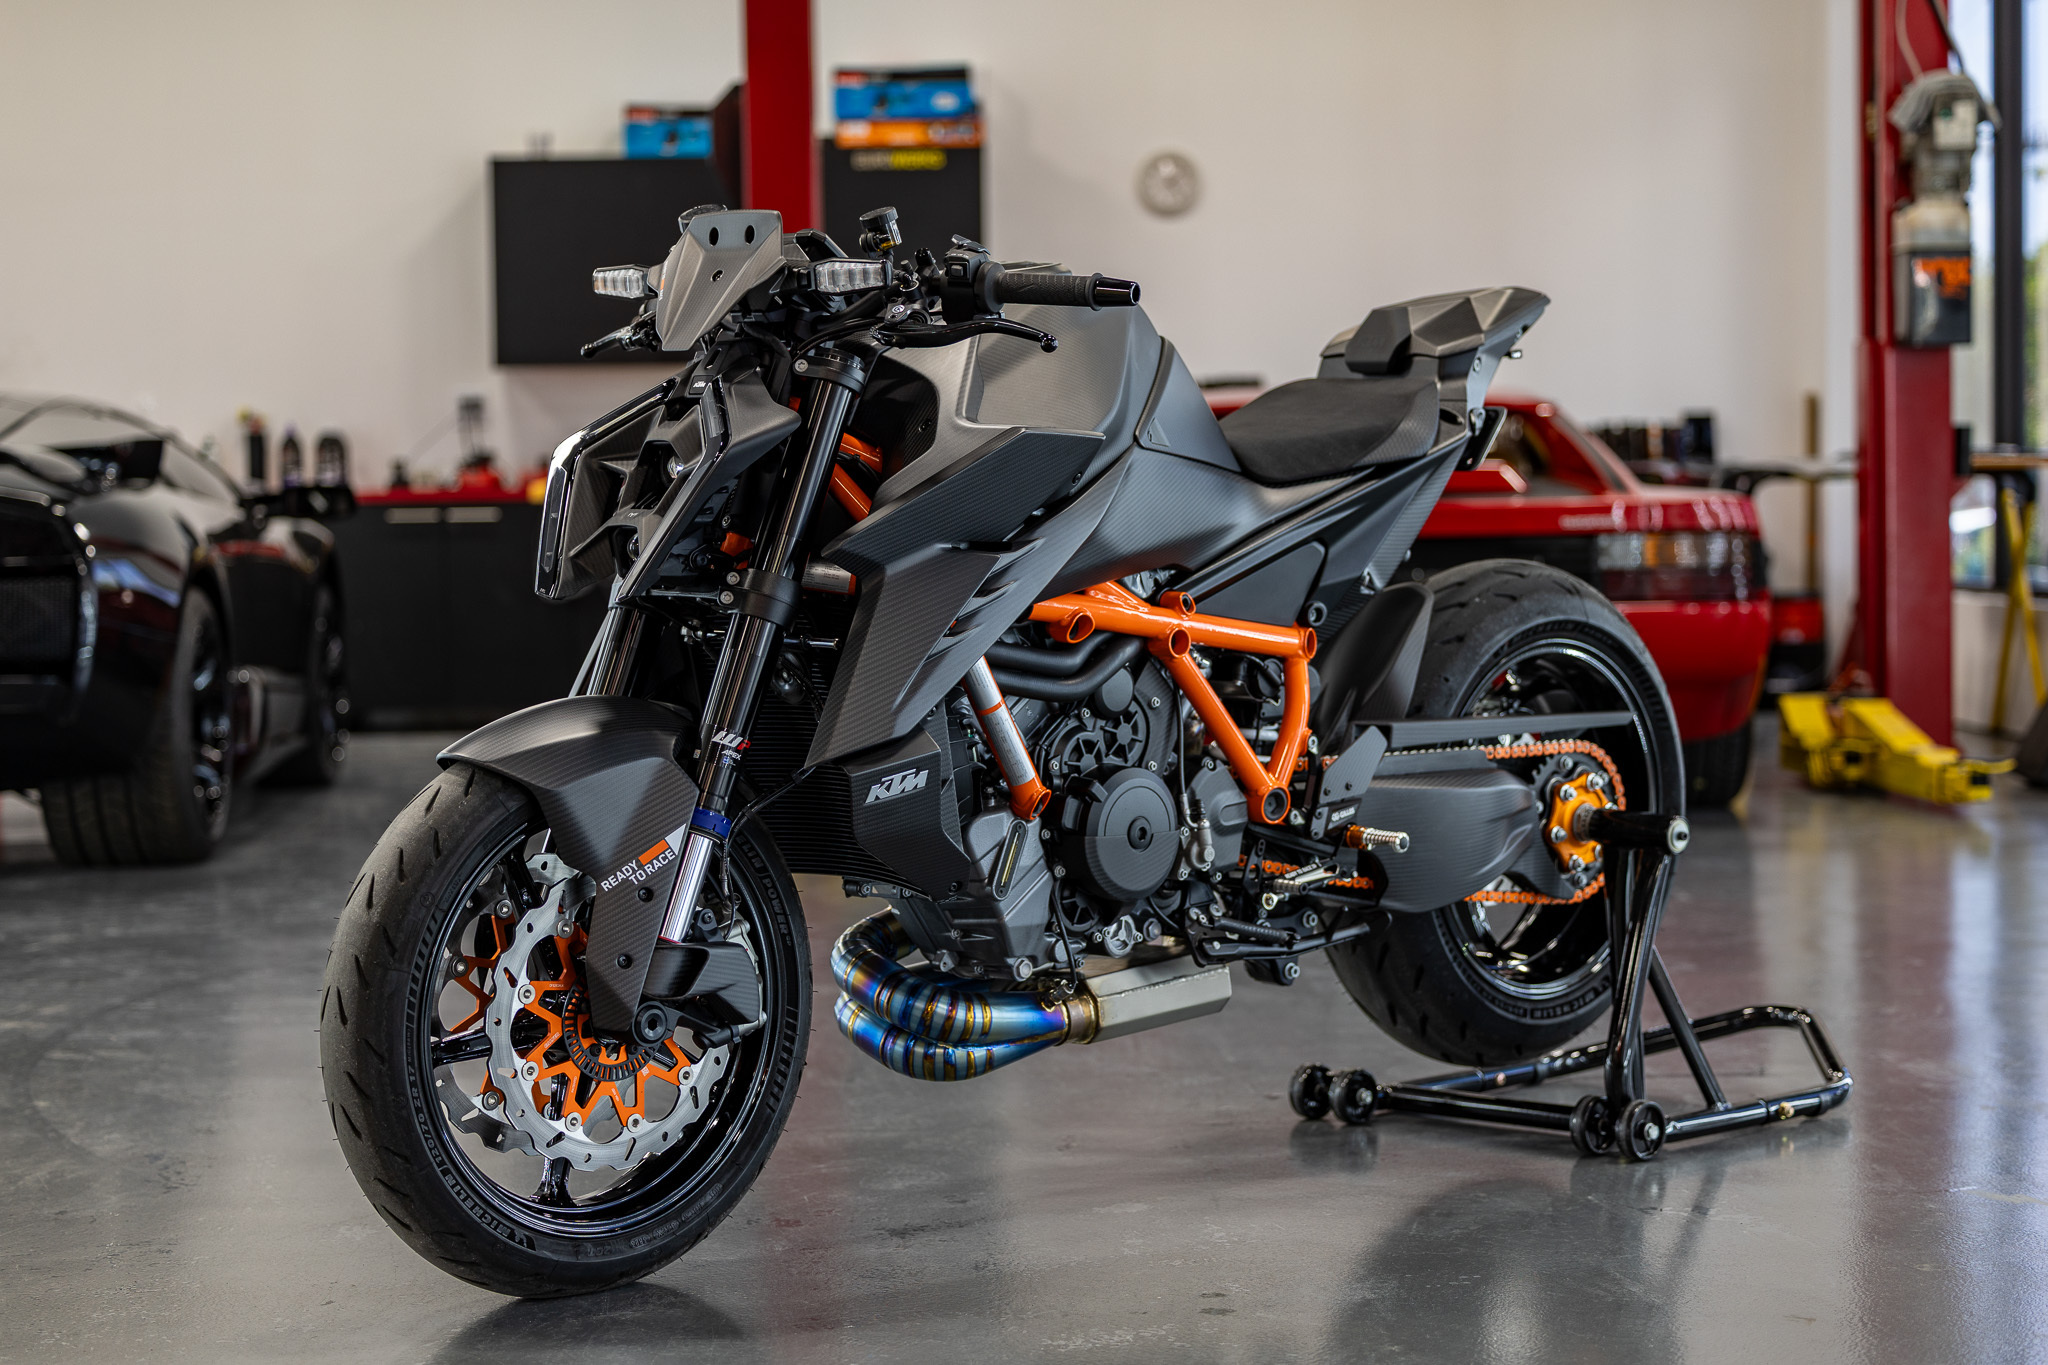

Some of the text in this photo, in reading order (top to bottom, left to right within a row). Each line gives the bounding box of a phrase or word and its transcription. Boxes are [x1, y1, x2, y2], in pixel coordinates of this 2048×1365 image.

[711, 730, 751, 750] WP
[721, 749, 742, 760] APEX
[865, 768, 929, 804] KTM
[600, 859, 638, 892] READY
[628, 848, 676, 885] TO RACE
[735, 834, 764, 869] ELIN
[762, 877, 789, 934] POWER
[1534, 991, 1595, 1017] MICHELIN
[407, 1067, 417, 1083] 17
[410, 1087, 421, 1108] ZR
[418, 1113, 442, 1164] 120/70
[443, 1172, 512, 1238] MICHELIN
